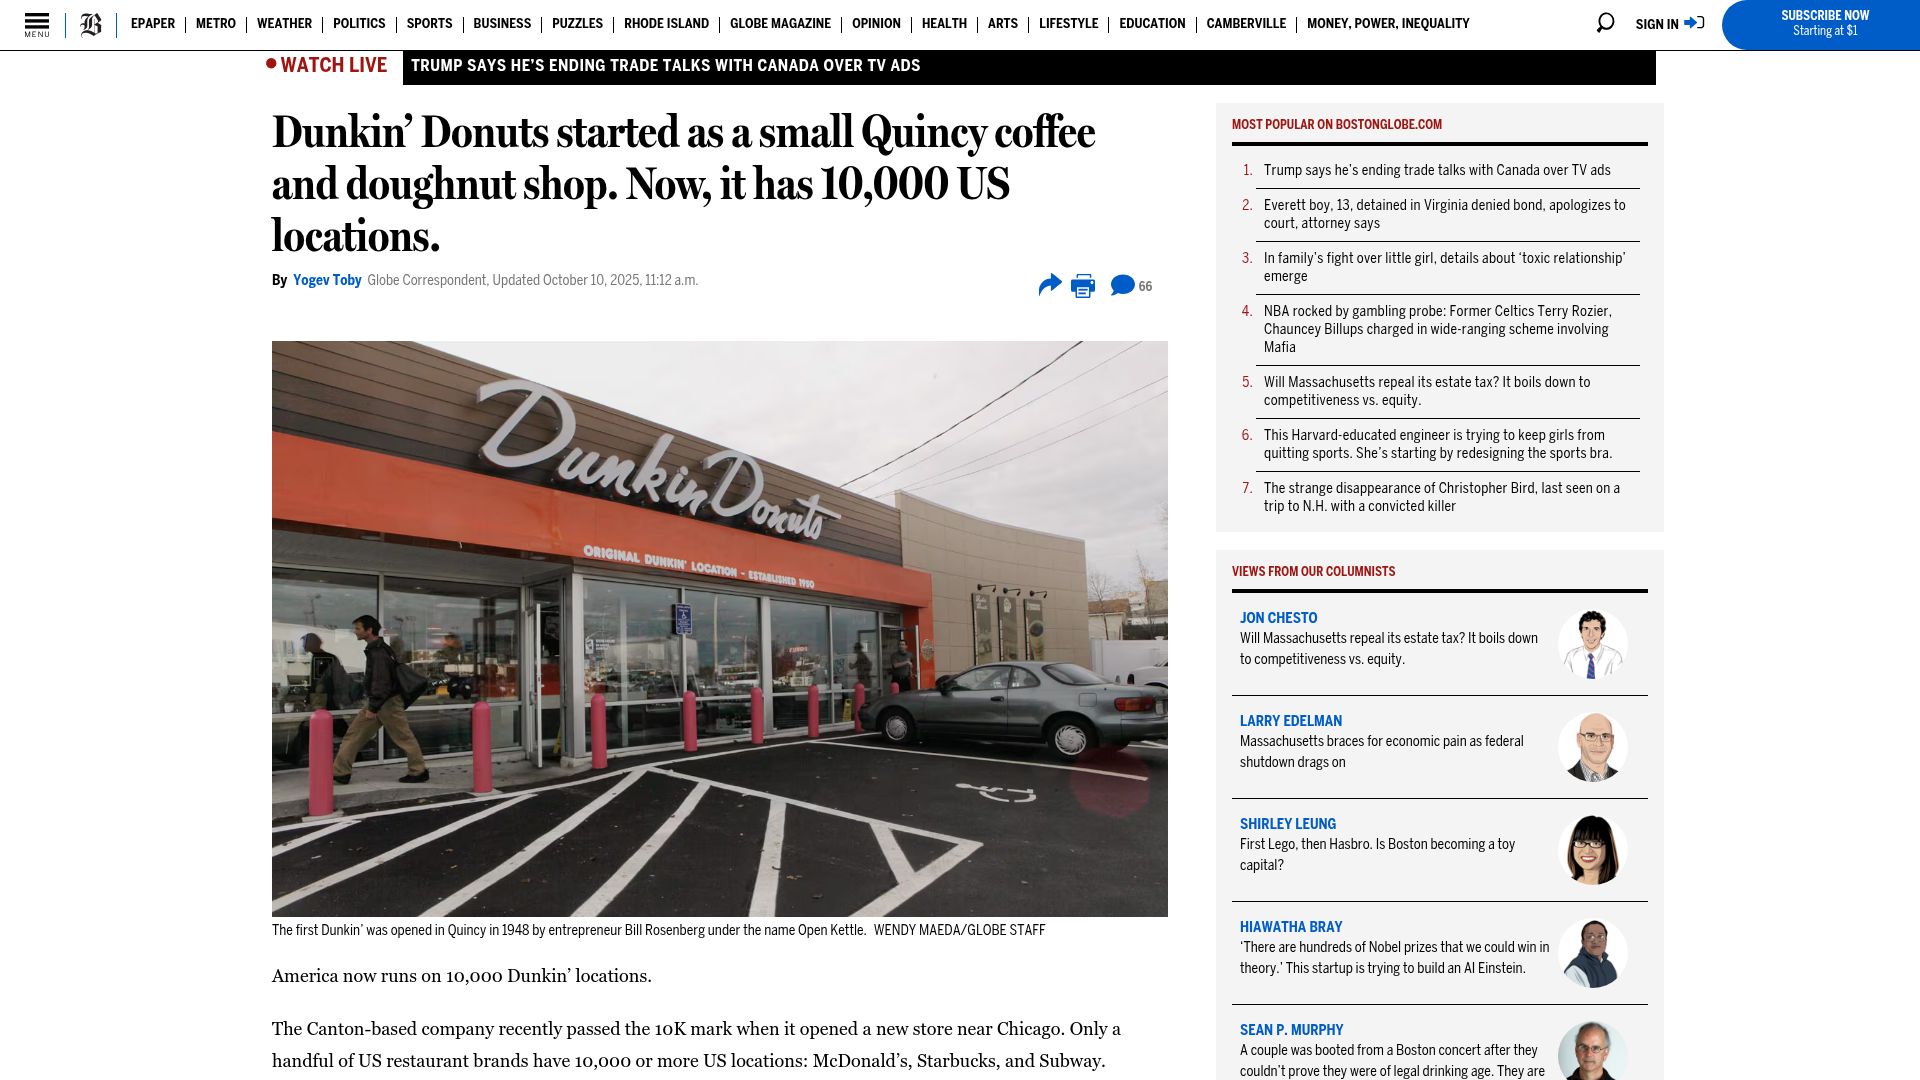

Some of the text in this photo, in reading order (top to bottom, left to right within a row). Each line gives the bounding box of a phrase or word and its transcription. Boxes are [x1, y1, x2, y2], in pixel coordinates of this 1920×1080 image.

[1782, 10, 1869, 20] SUBSCRIBE NOW
[132, 18, 175, 28] EPAPER
[197, 18, 236, 28] METRO
[257, 18, 312, 28] WEATHER
[334, 18, 385, 28] POLITICS
[407, 18, 452, 28] SPORTS
[474, 18, 531, 28] BUSINESS
[553, 18, 603, 28] PUZZLES
[624, 18, 710, 28] RHODE ISLAND
[730, 18, 831, 28] GLOBE MAGAZINE
[852, 18, 900, 28] OPINION
[923, 18, 967, 28] HEALTH
[988, 18, 1018, 28] ARTS
[1040, 18, 1098, 28] LIFESTYLE
[1120, 18, 1185, 28] EDUCATION
[1207, 18, 1286, 28] CAMBERVILLE
[1308, 18, 1470, 31] MONEY, POWER, INEQUALITY
[1636, 19, 1678, 29] SIGN IN
[1794, 24, 1858, 38] Starting at $1
[281, 57, 388, 73] WATCH LIVE
[411, 59, 920, 71] TRUMP SAYS HE’S ENDING TRADE TALKS WITH CANADA OVER TV ADS
[1232, 119, 1442, 129] MOST POPULAR ON BOSTONGLOBE.COM
[272, 113, 1095, 157] Dunkin’ Donuts started as a small Quincy coffee
[1244, 164, 1610, 178] 1. Trump says he’s ending trade talks with Canada over TV ads
[273, 165, 1009, 209] and doughnut shop. Now, it has 10,000 US
[271, 217, 439, 252] locations.
[273, 274, 362, 288] By Yogev Toby
[368, 274, 698, 288] Globe Correspondent, Updated October 10, 2025, 11:12 a.m.
[1264, 273, 1307, 284] emerge
[1139, 281, 1152, 291] 66
[1265, 341, 1295, 352] Mafia
[477, 379, 842, 540] Dunkin Donuts
[583, 545, 640, 563] ORIGINAL
[691, 561, 737, 577] LOCATION
[749, 570, 796, 586] ESTABLISHED
[1232, 566, 1395, 576] VIEWS FROM OUR COLUMNISTS
[1240, 612, 1317, 623] JON CHESTO
[1241, 715, 1342, 726] LARRY EDELMAN
[1240, 818, 1336, 829] SHIRLEY LEUNG
[1241, 838, 1515, 852] First Lego, then Hasbro. Is Boston becoming a toy
[1240, 859, 1284, 873] capital?
[272, 924, 1046, 938] The first Dunkin’ was opened in Quincy in 1948 by entrepreneur Bill Rosenberg under the name Open Kettle. WENDY MAEDA/GLOBE STAFF
[1241, 921, 1342, 932] HIAWATHA BRAY
[272, 968, 651, 985] America now runs on 10,000 Dunkin’ locations.
[1240, 1024, 1343, 1035] SEAN P. MURPHY
